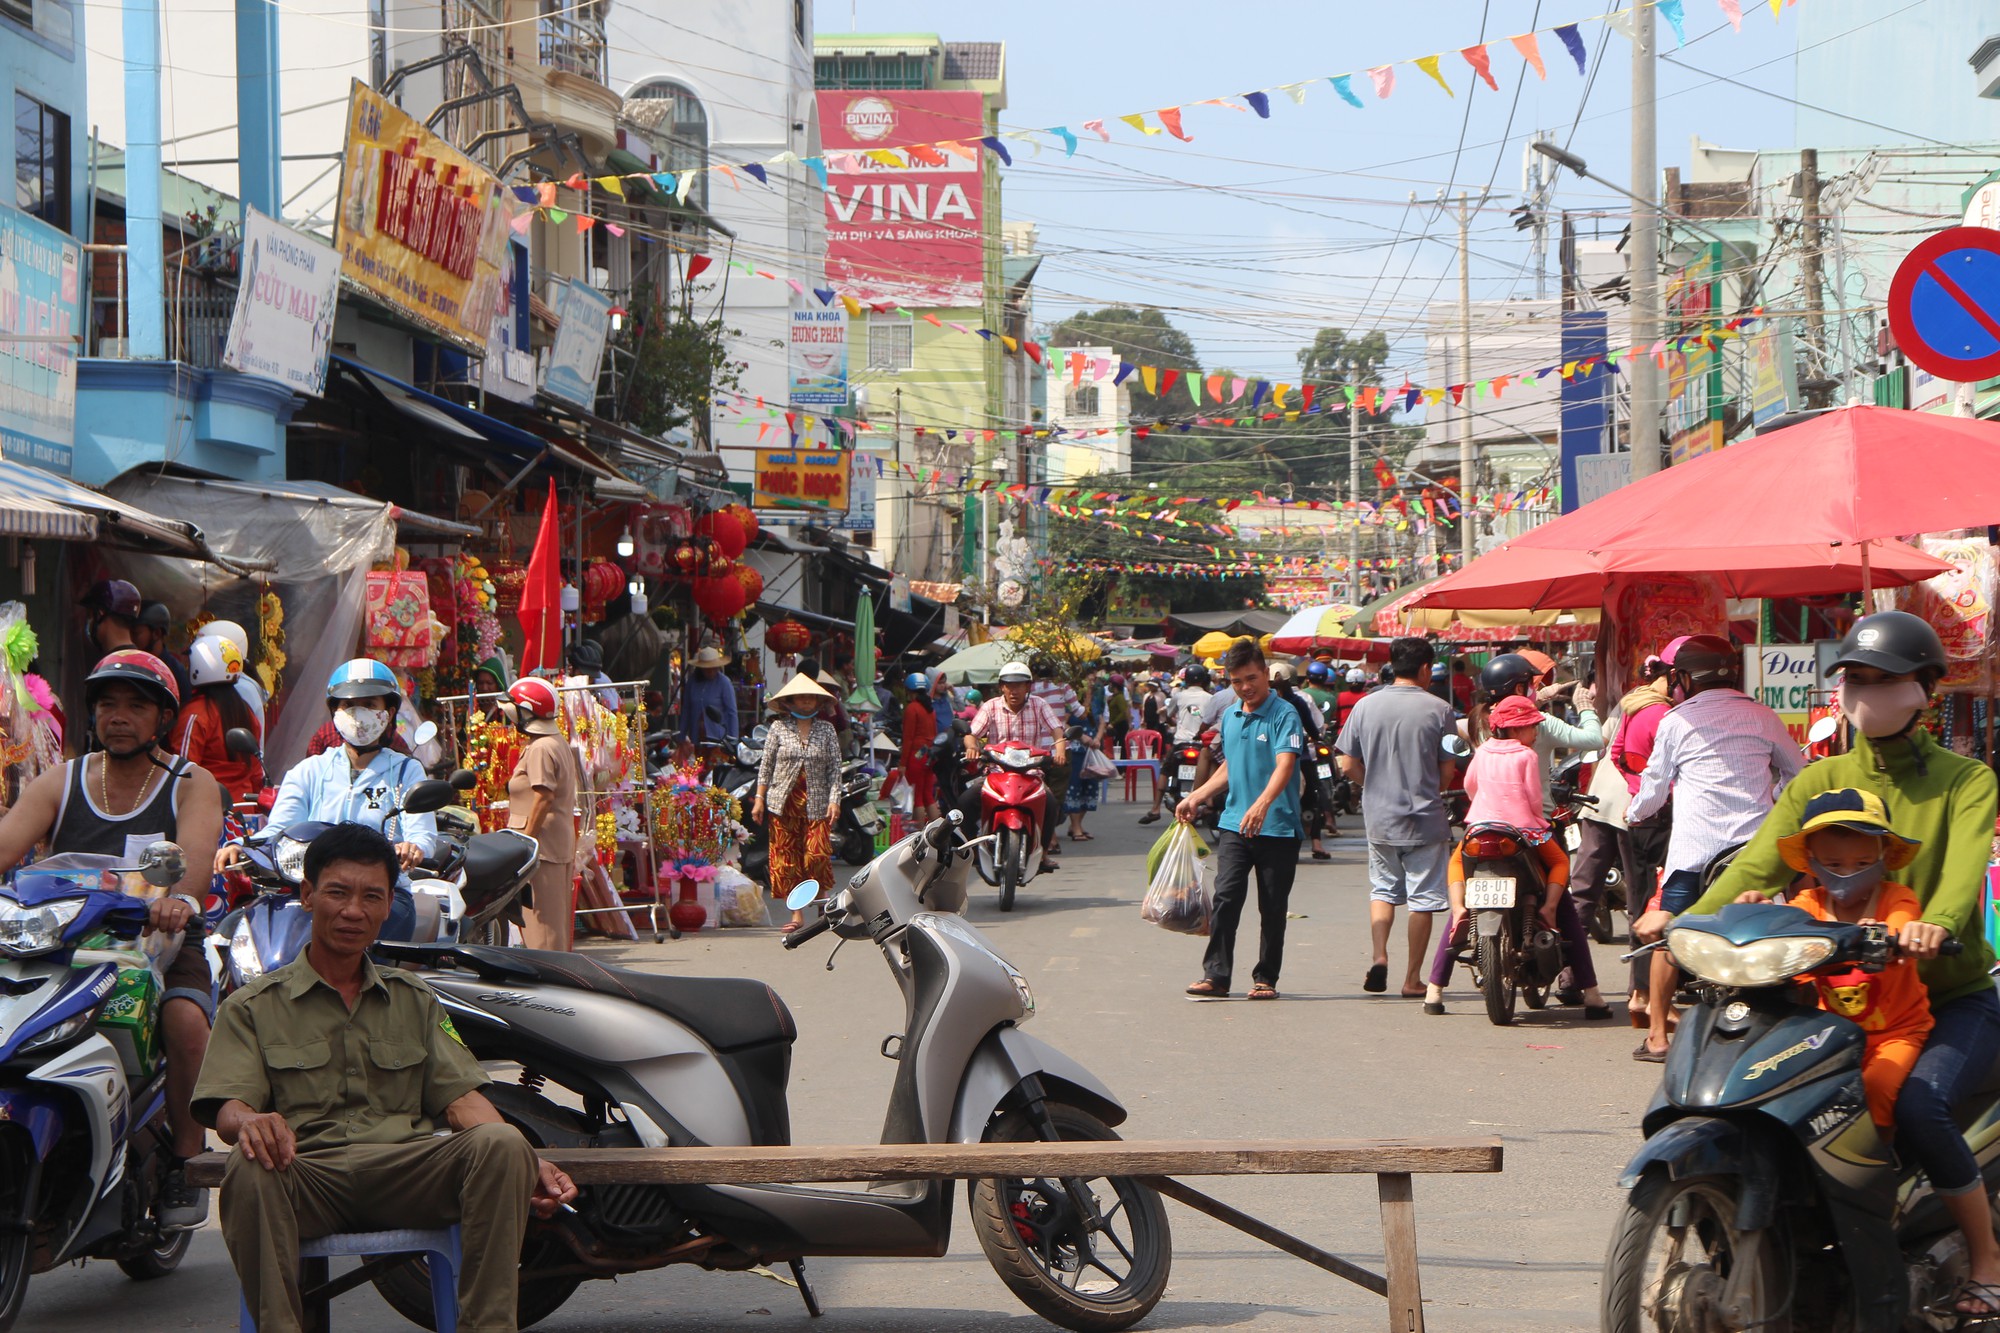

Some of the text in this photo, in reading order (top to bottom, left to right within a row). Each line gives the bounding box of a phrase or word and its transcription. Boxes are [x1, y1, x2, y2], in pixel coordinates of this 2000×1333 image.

[847, 113, 893, 125] BIVINA
[287, 285, 317, 323] MAI
[795, 311, 840, 321] NHA KHOA
[820, 321, 844, 343] PHÁT
[760, 467, 841, 500] PHÚC NGỌC
[1475, 880, 1508, 892] 68-U1
[1474, 893, 1508, 906] 2986
[91, 973, 117, 998] YAMAHA
